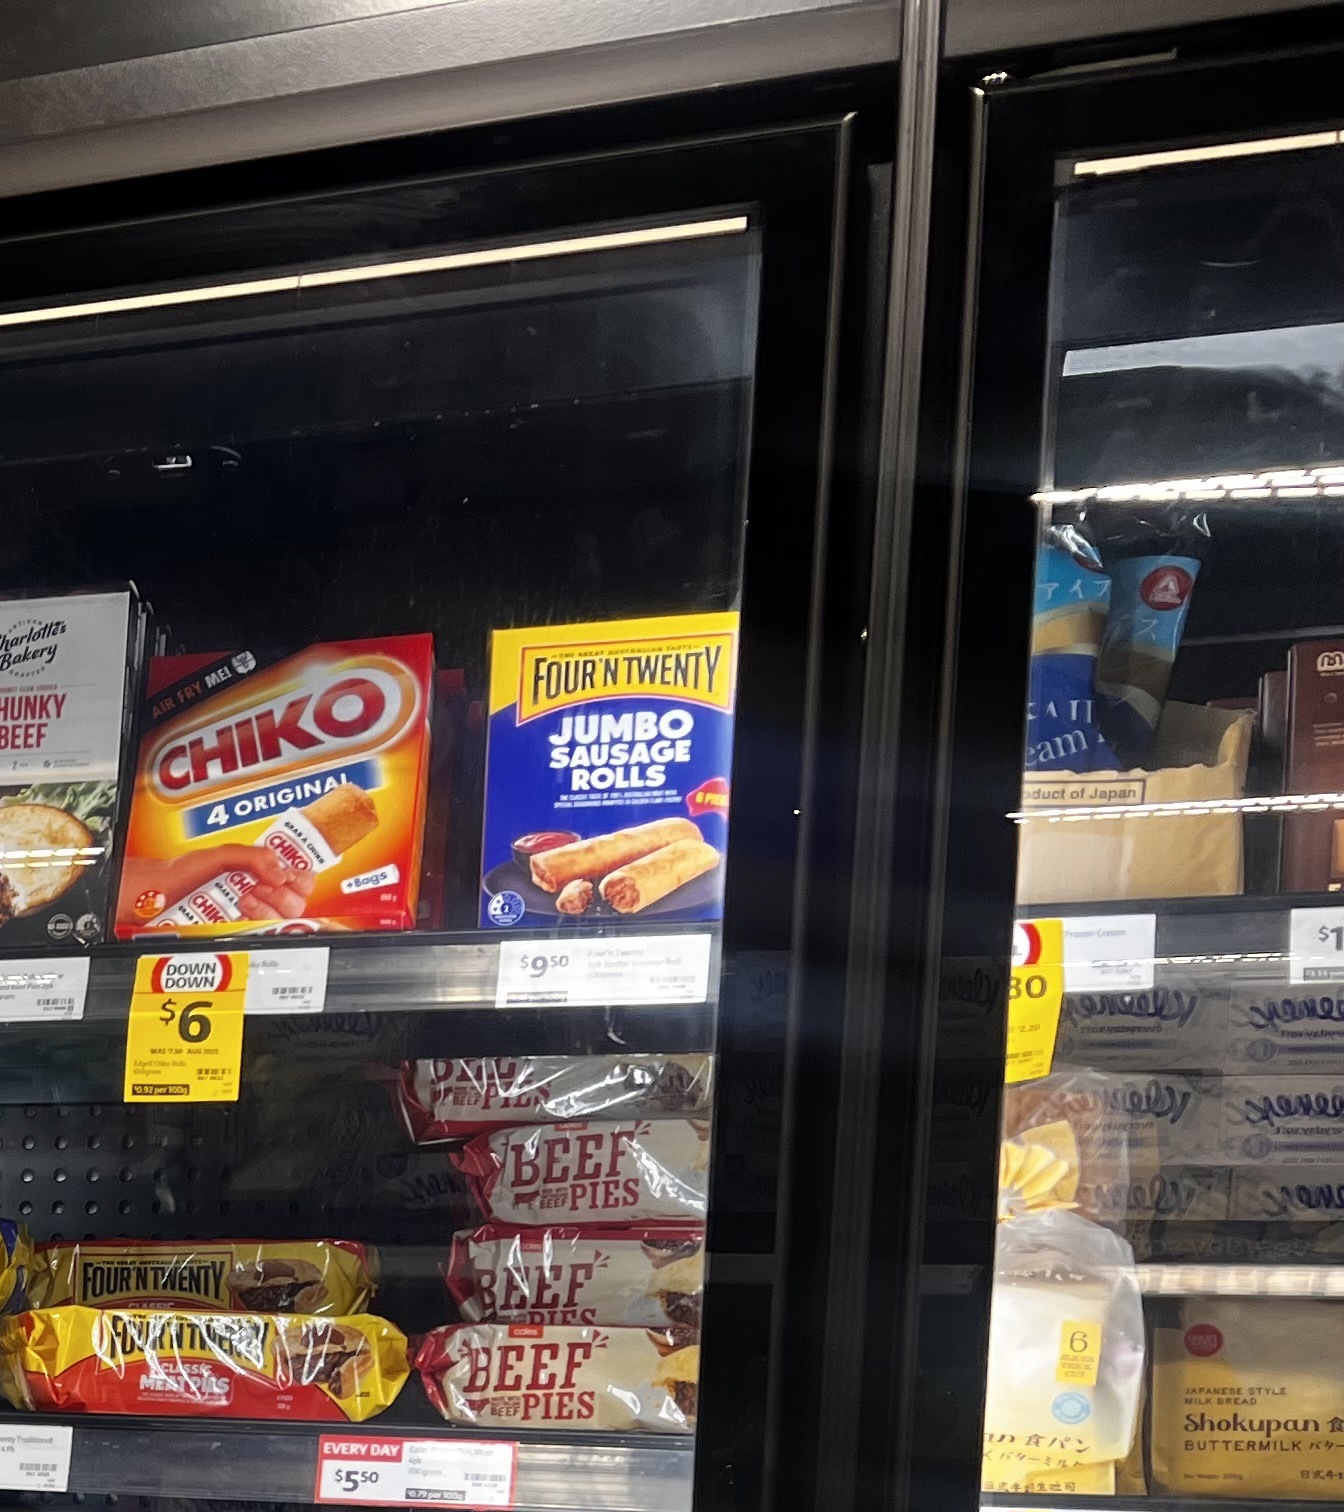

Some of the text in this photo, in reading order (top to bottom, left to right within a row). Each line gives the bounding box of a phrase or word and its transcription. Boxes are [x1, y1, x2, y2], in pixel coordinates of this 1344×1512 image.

[532, 644, 723, 707] FOUR'N TWENTY
[151, 666, 233, 719] AIR FRY ME!
[158, 676, 386, 791] CHIKO
[548, 709, 695, 747] JUMBO
[548, 739, 691, 770] SAUSAGE
[571, 766, 666, 791] ROLLS
[1071, 786, 1137, 802] of Japan
[207, 772, 354, 827] 4 ORIGINAL
[267, 832, 310, 872] CHIKO
[165, 975, 216, 990] DOWN
[166, 961, 217, 977] DOWN
[159, 997, 214, 1044] $6
[510, 1131, 634, 1186] BEEF
[569, 1178, 640, 1211] PIES
[520, 1390, 596, 1421] PIES
[1184, 1386, 1287, 1396] JAPANESE STYLE
[1184, 1397, 1257, 1406] MILK BREAD
[1183, 1412, 1320, 1435] Shokupan
[322, 1442, 400, 1458] EVERY DAY
[1183, 1439, 1303, 1452] BUTTERMILK
